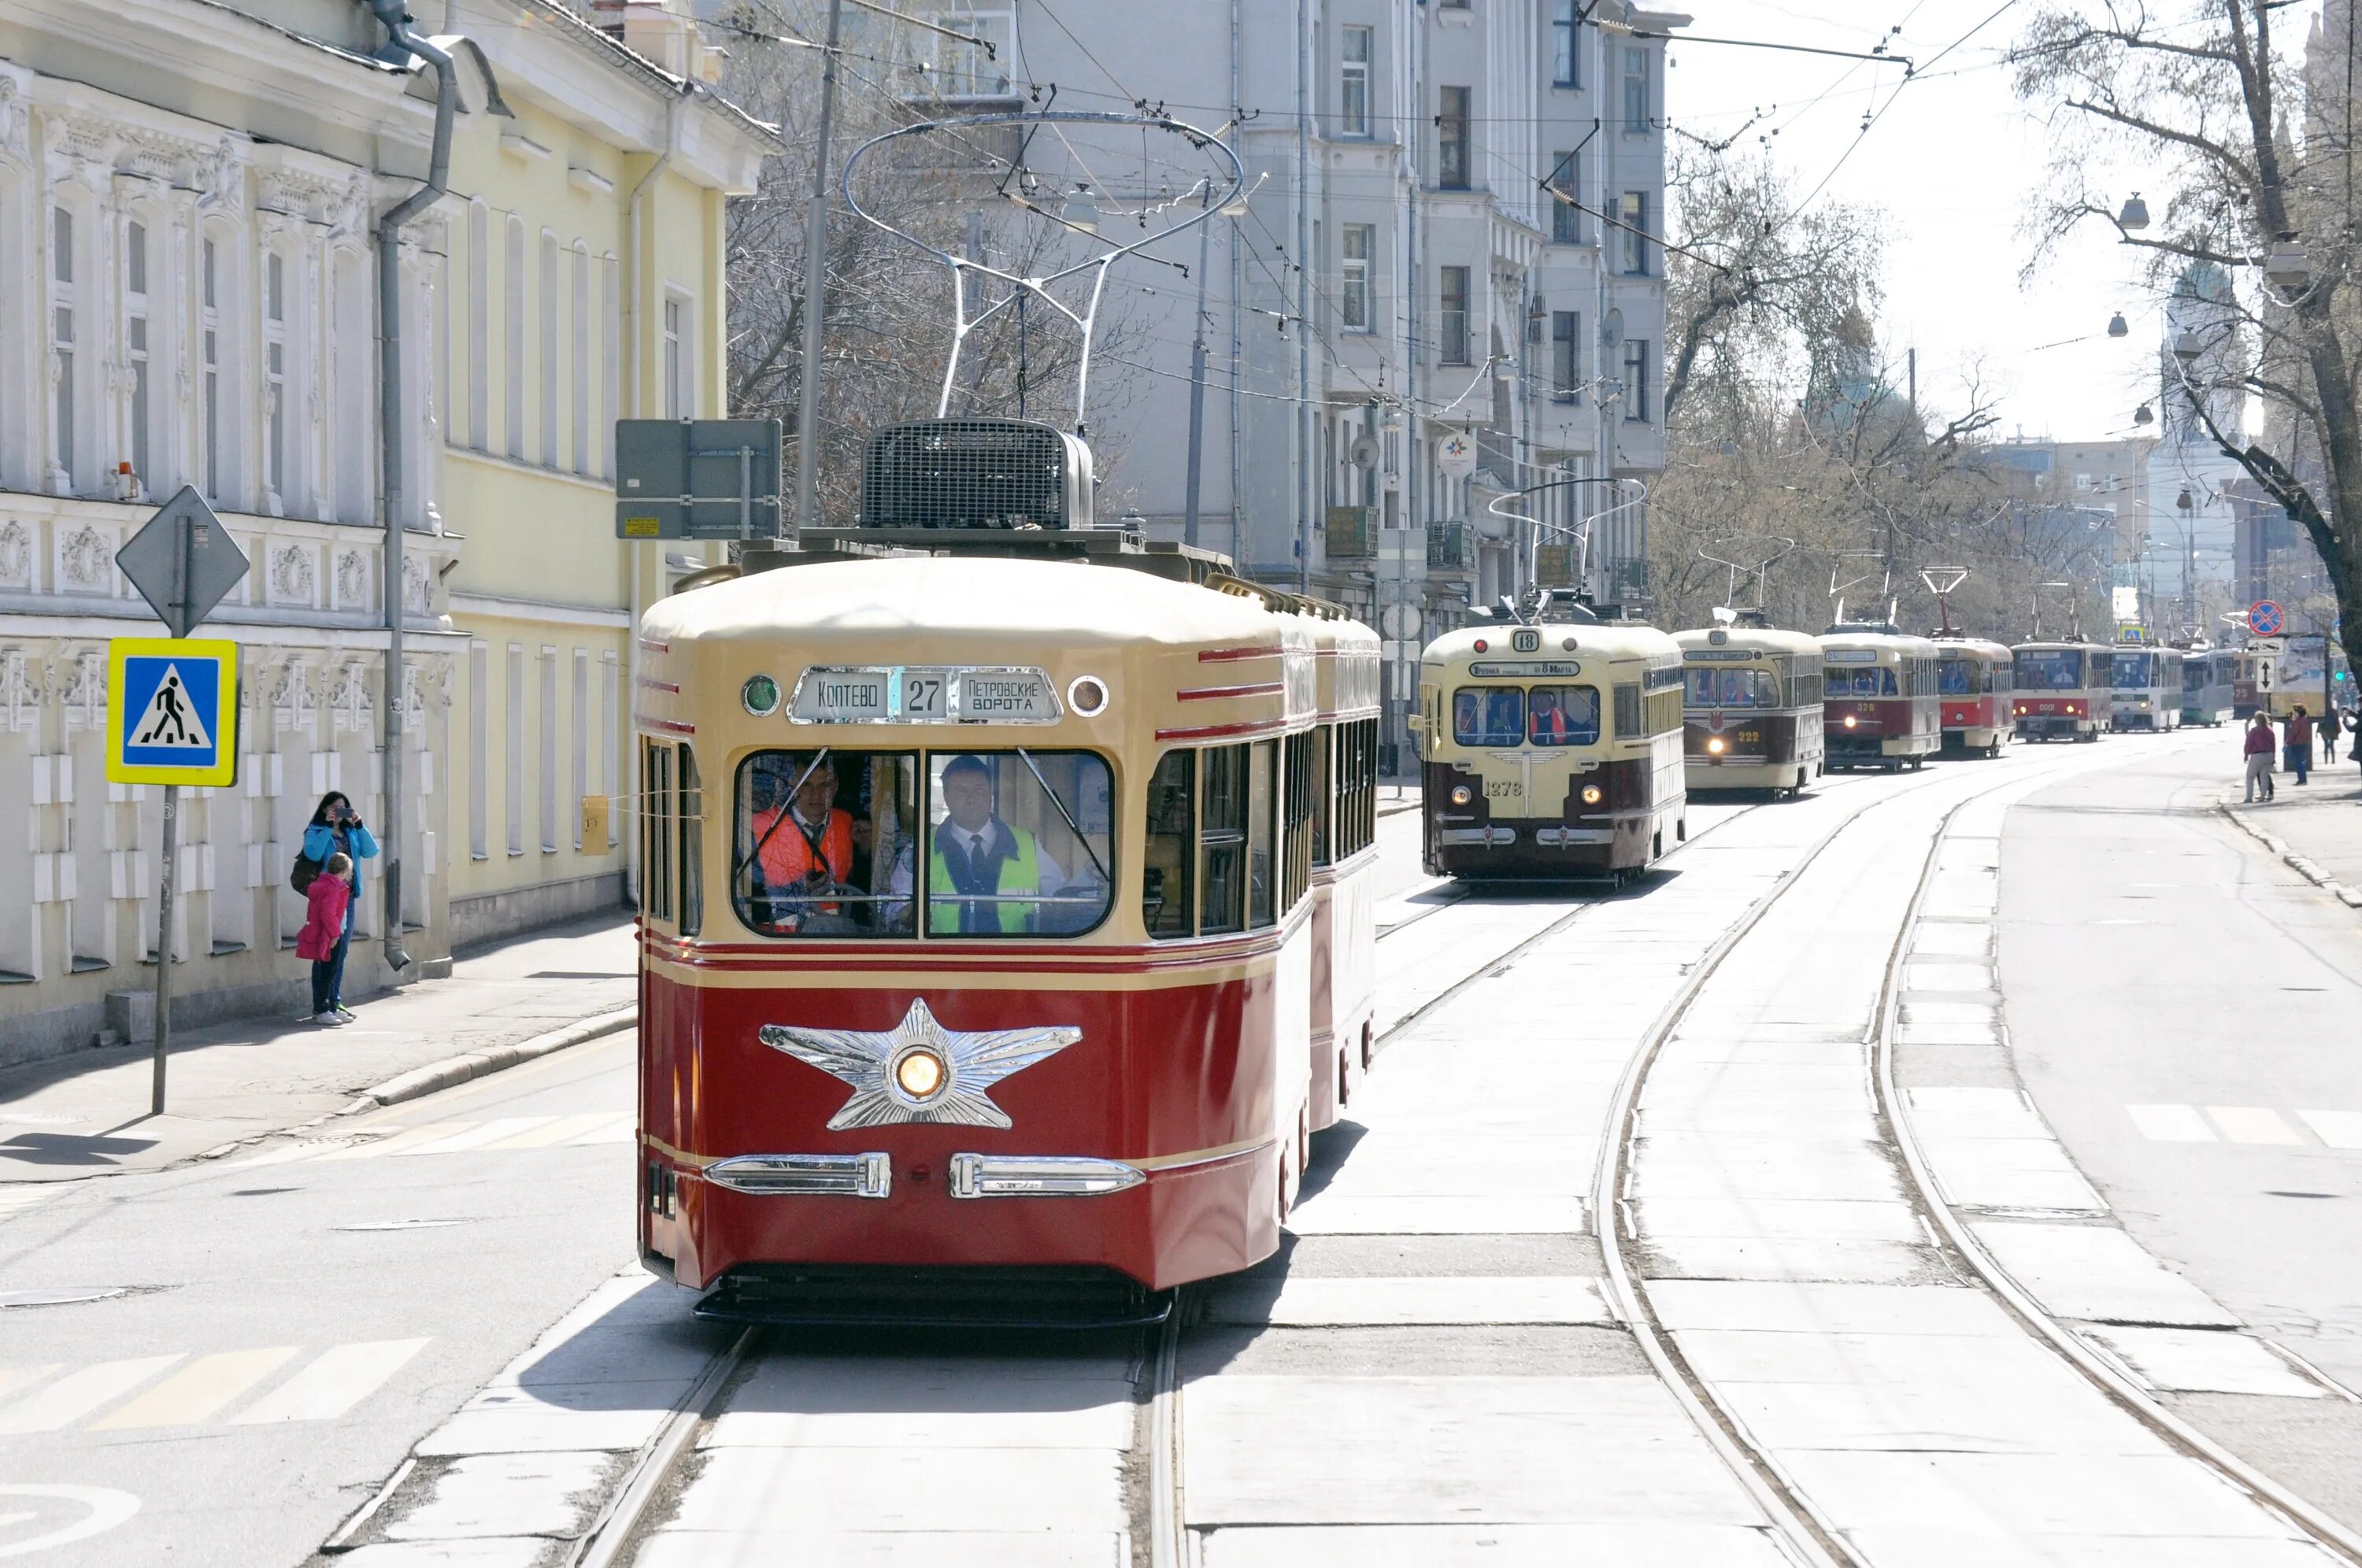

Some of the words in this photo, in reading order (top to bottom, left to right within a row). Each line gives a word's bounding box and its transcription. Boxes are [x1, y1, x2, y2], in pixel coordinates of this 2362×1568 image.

[1519, 634, 1534, 649] 18
[818, 681, 878, 708] КОПТЕВО
[909, 680, 939, 711] 27
[968, 679, 1038, 697] ПЕТРОВСКИЕ
[972, 698, 1034, 710] ВОРОТА
[1738, 730, 1759, 742] 222
